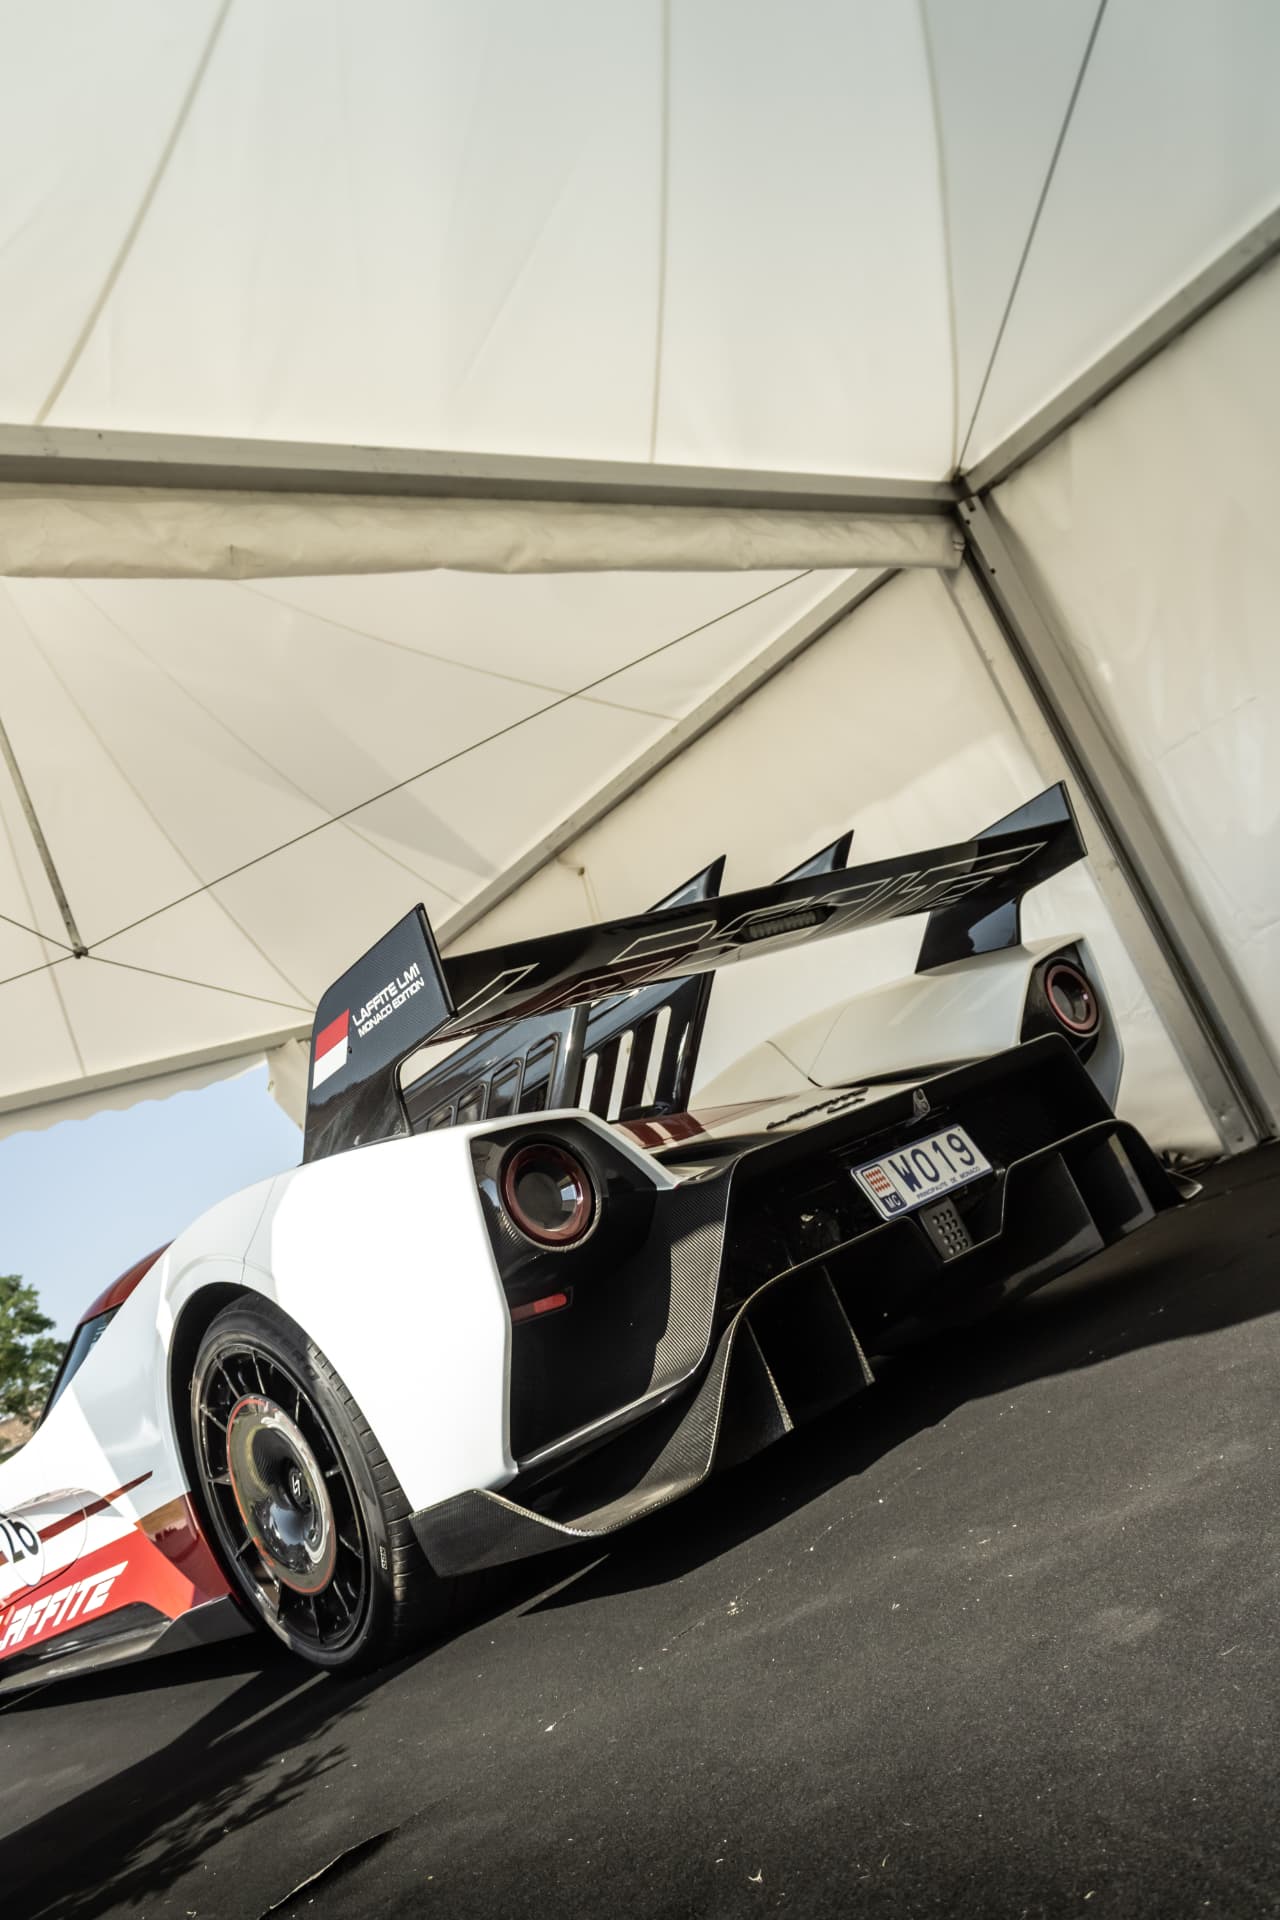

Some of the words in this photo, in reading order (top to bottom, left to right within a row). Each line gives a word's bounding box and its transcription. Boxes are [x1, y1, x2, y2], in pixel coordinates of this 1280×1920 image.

[352, 981, 398, 1026] LAFFITE
[396, 962, 421, 990] LM1
[357, 1004, 394, 1038] MONACO
[392, 977, 425, 1009] EDITION
[886, 1196, 902, 1208] MC
